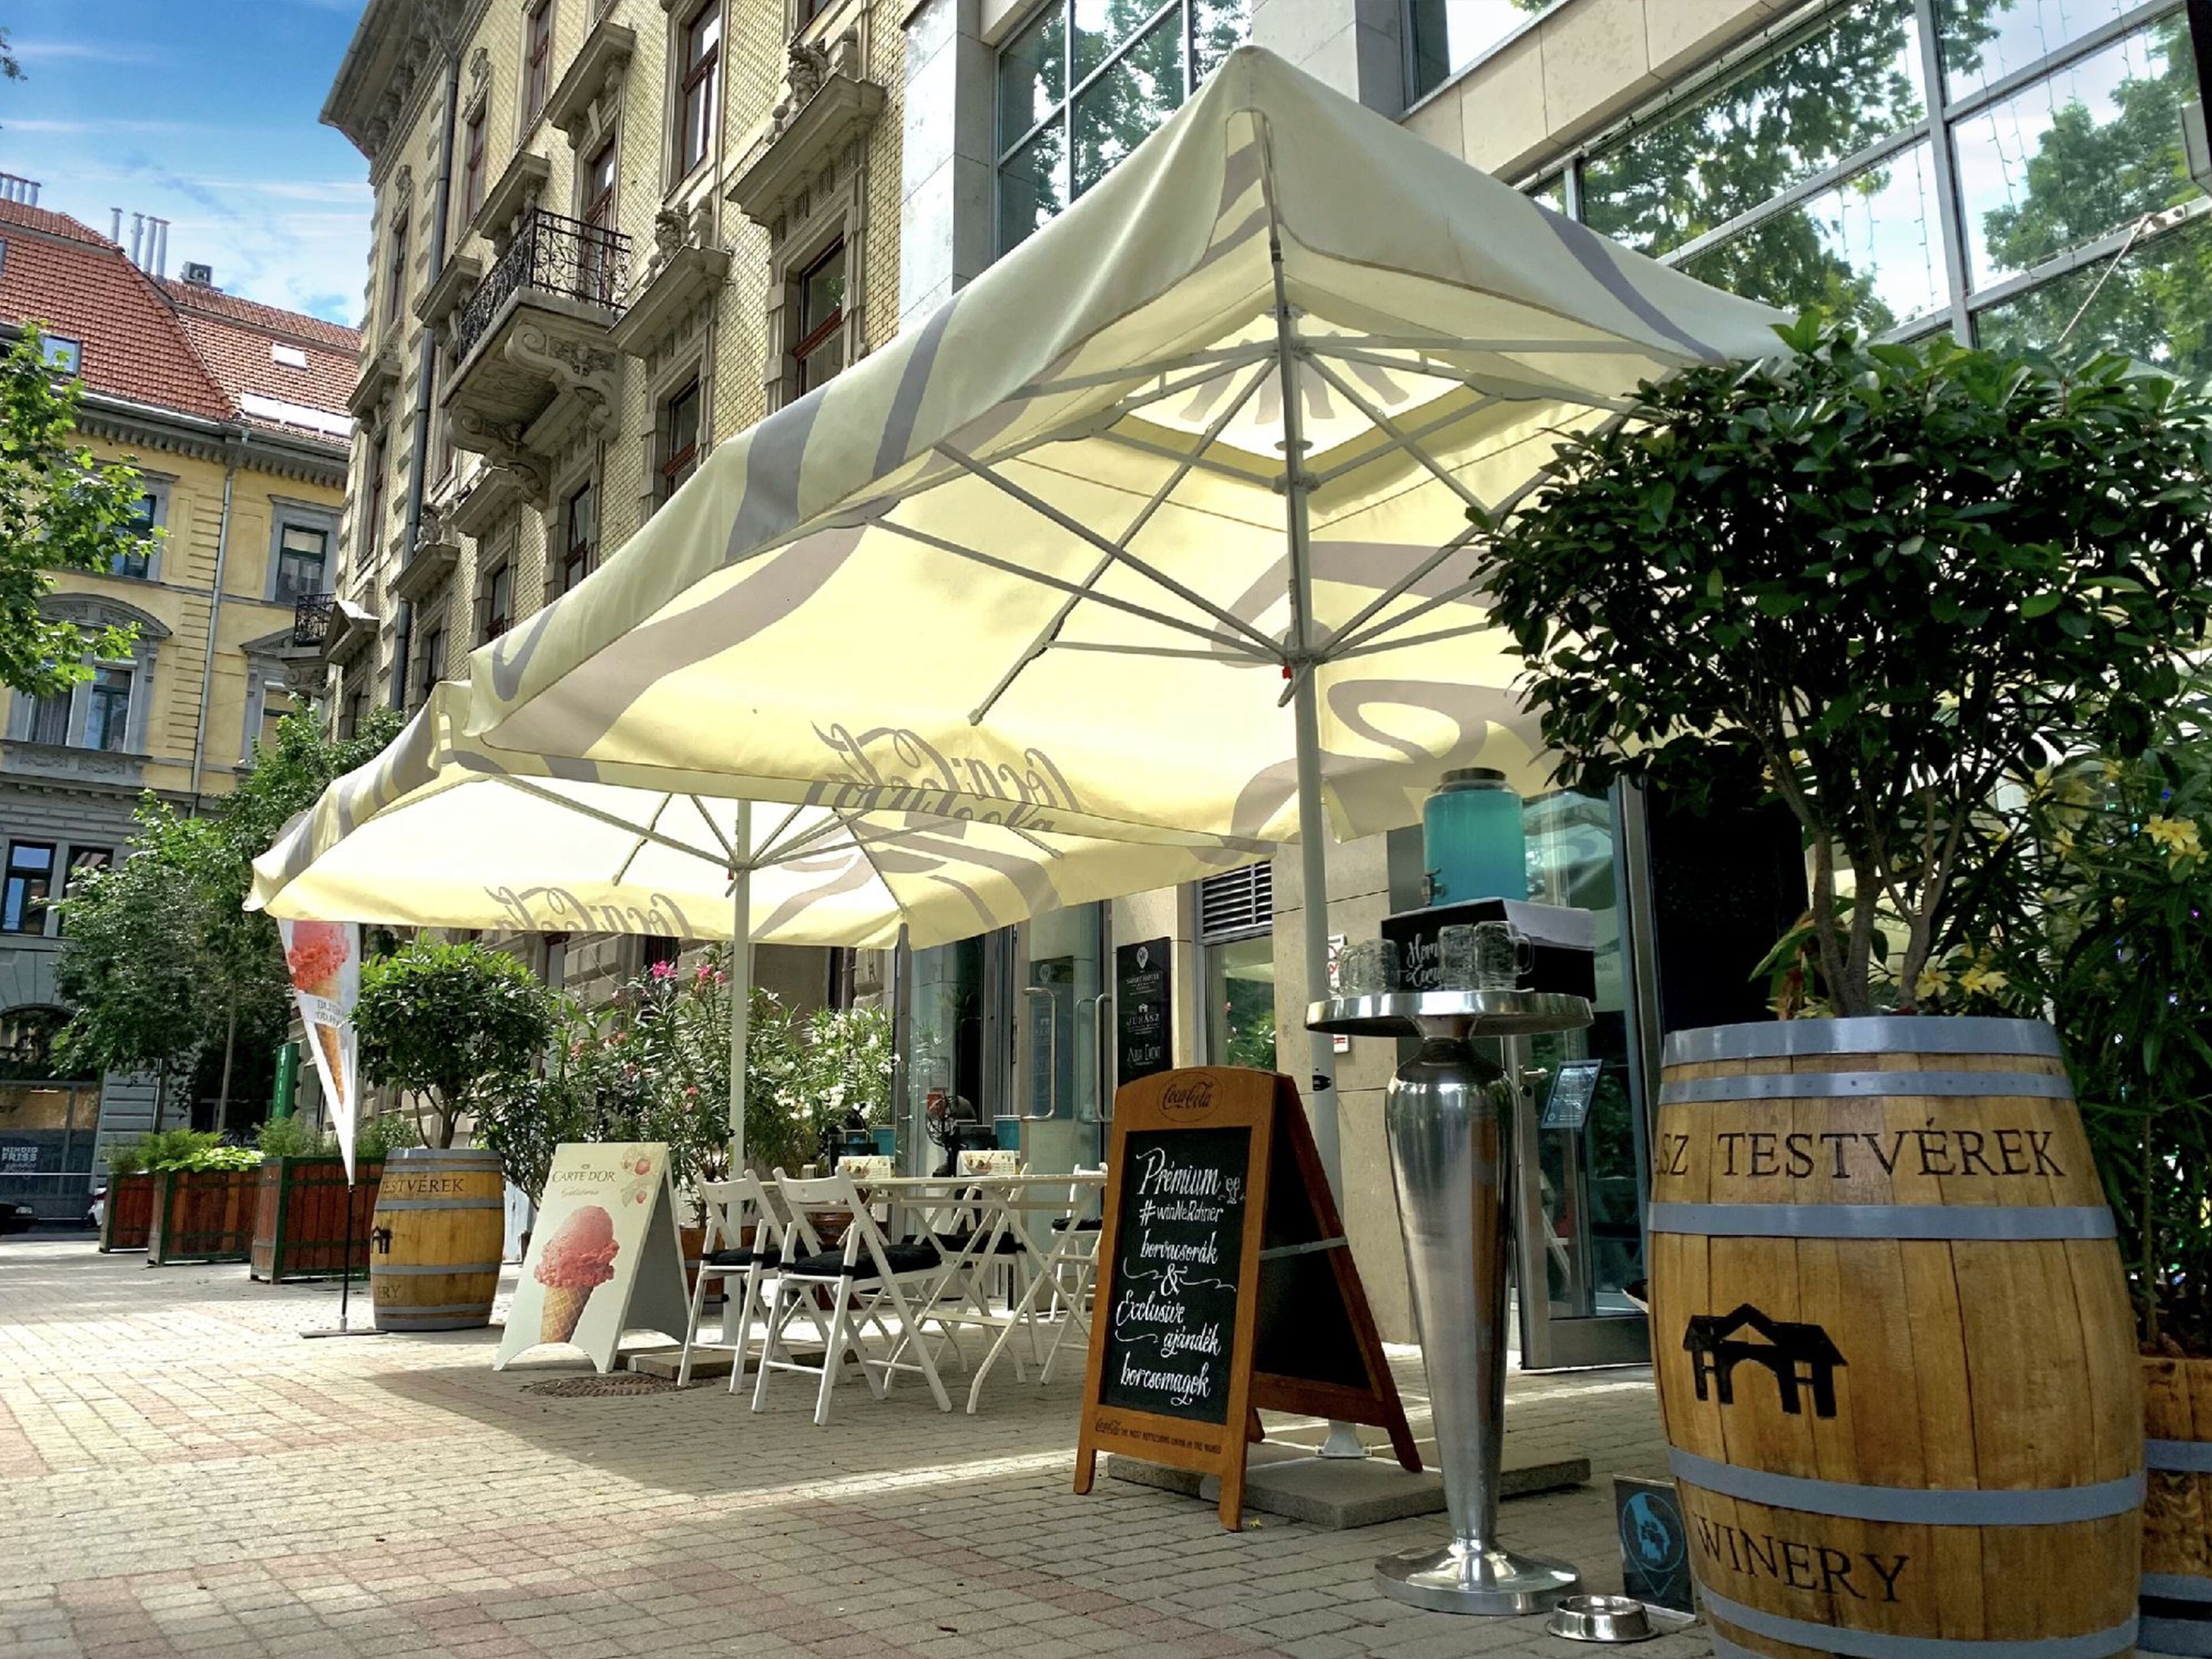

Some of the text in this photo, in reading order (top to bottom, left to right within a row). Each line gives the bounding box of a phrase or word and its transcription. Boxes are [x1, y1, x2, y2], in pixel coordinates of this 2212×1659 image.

[1162, 1081, 1215, 1111] Coca-Cola
[1717, 1118, 2067, 1179] TESTVÉREK
[552, 1170, 585, 1183] CARTE
[1136, 1147, 1221, 1196] Prémium
[1140, 1228, 1218, 1264] borvacsorák
[1161, 1263, 1188, 1296] &
[1116, 1289, 1185, 1326] Exclusive
[1160, 1322, 1221, 1358] ajándék
[1120, 1351, 1211, 1406] borcsomagok
[1693, 1510, 1912, 1603] WINERY
